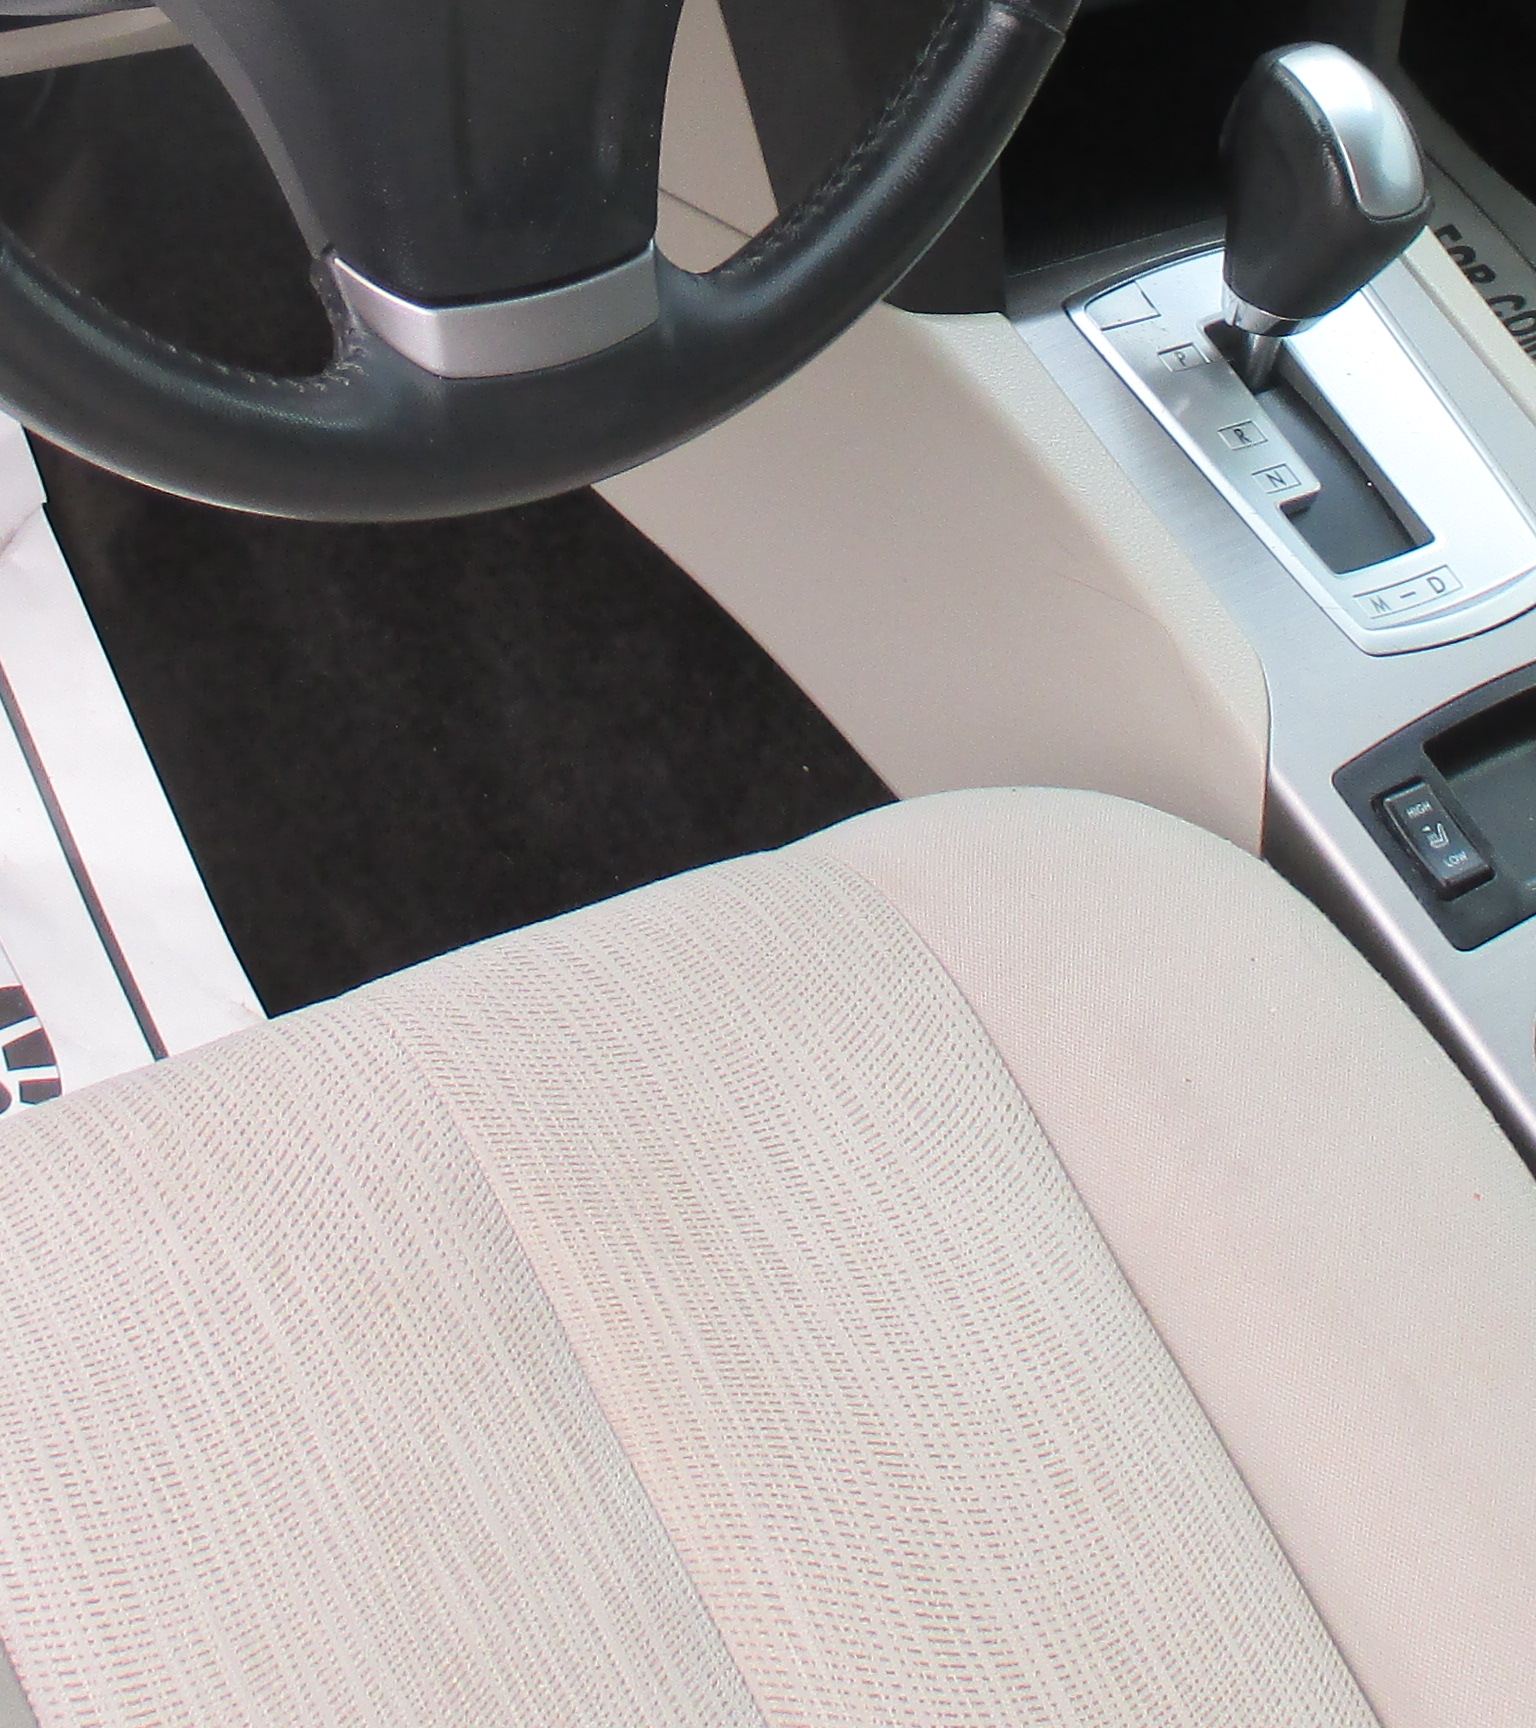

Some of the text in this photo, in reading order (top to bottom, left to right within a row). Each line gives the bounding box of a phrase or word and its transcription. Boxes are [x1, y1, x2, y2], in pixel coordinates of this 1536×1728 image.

[1172, 350, 1187, 367] P
[1233, 428, 1252, 445] R
[1266, 470, 1287, 488] N
[1368, 575, 1447, 615] M D
[1405, 800, 1433, 819] HIGH
[1443, 850, 1468, 868] LOW
